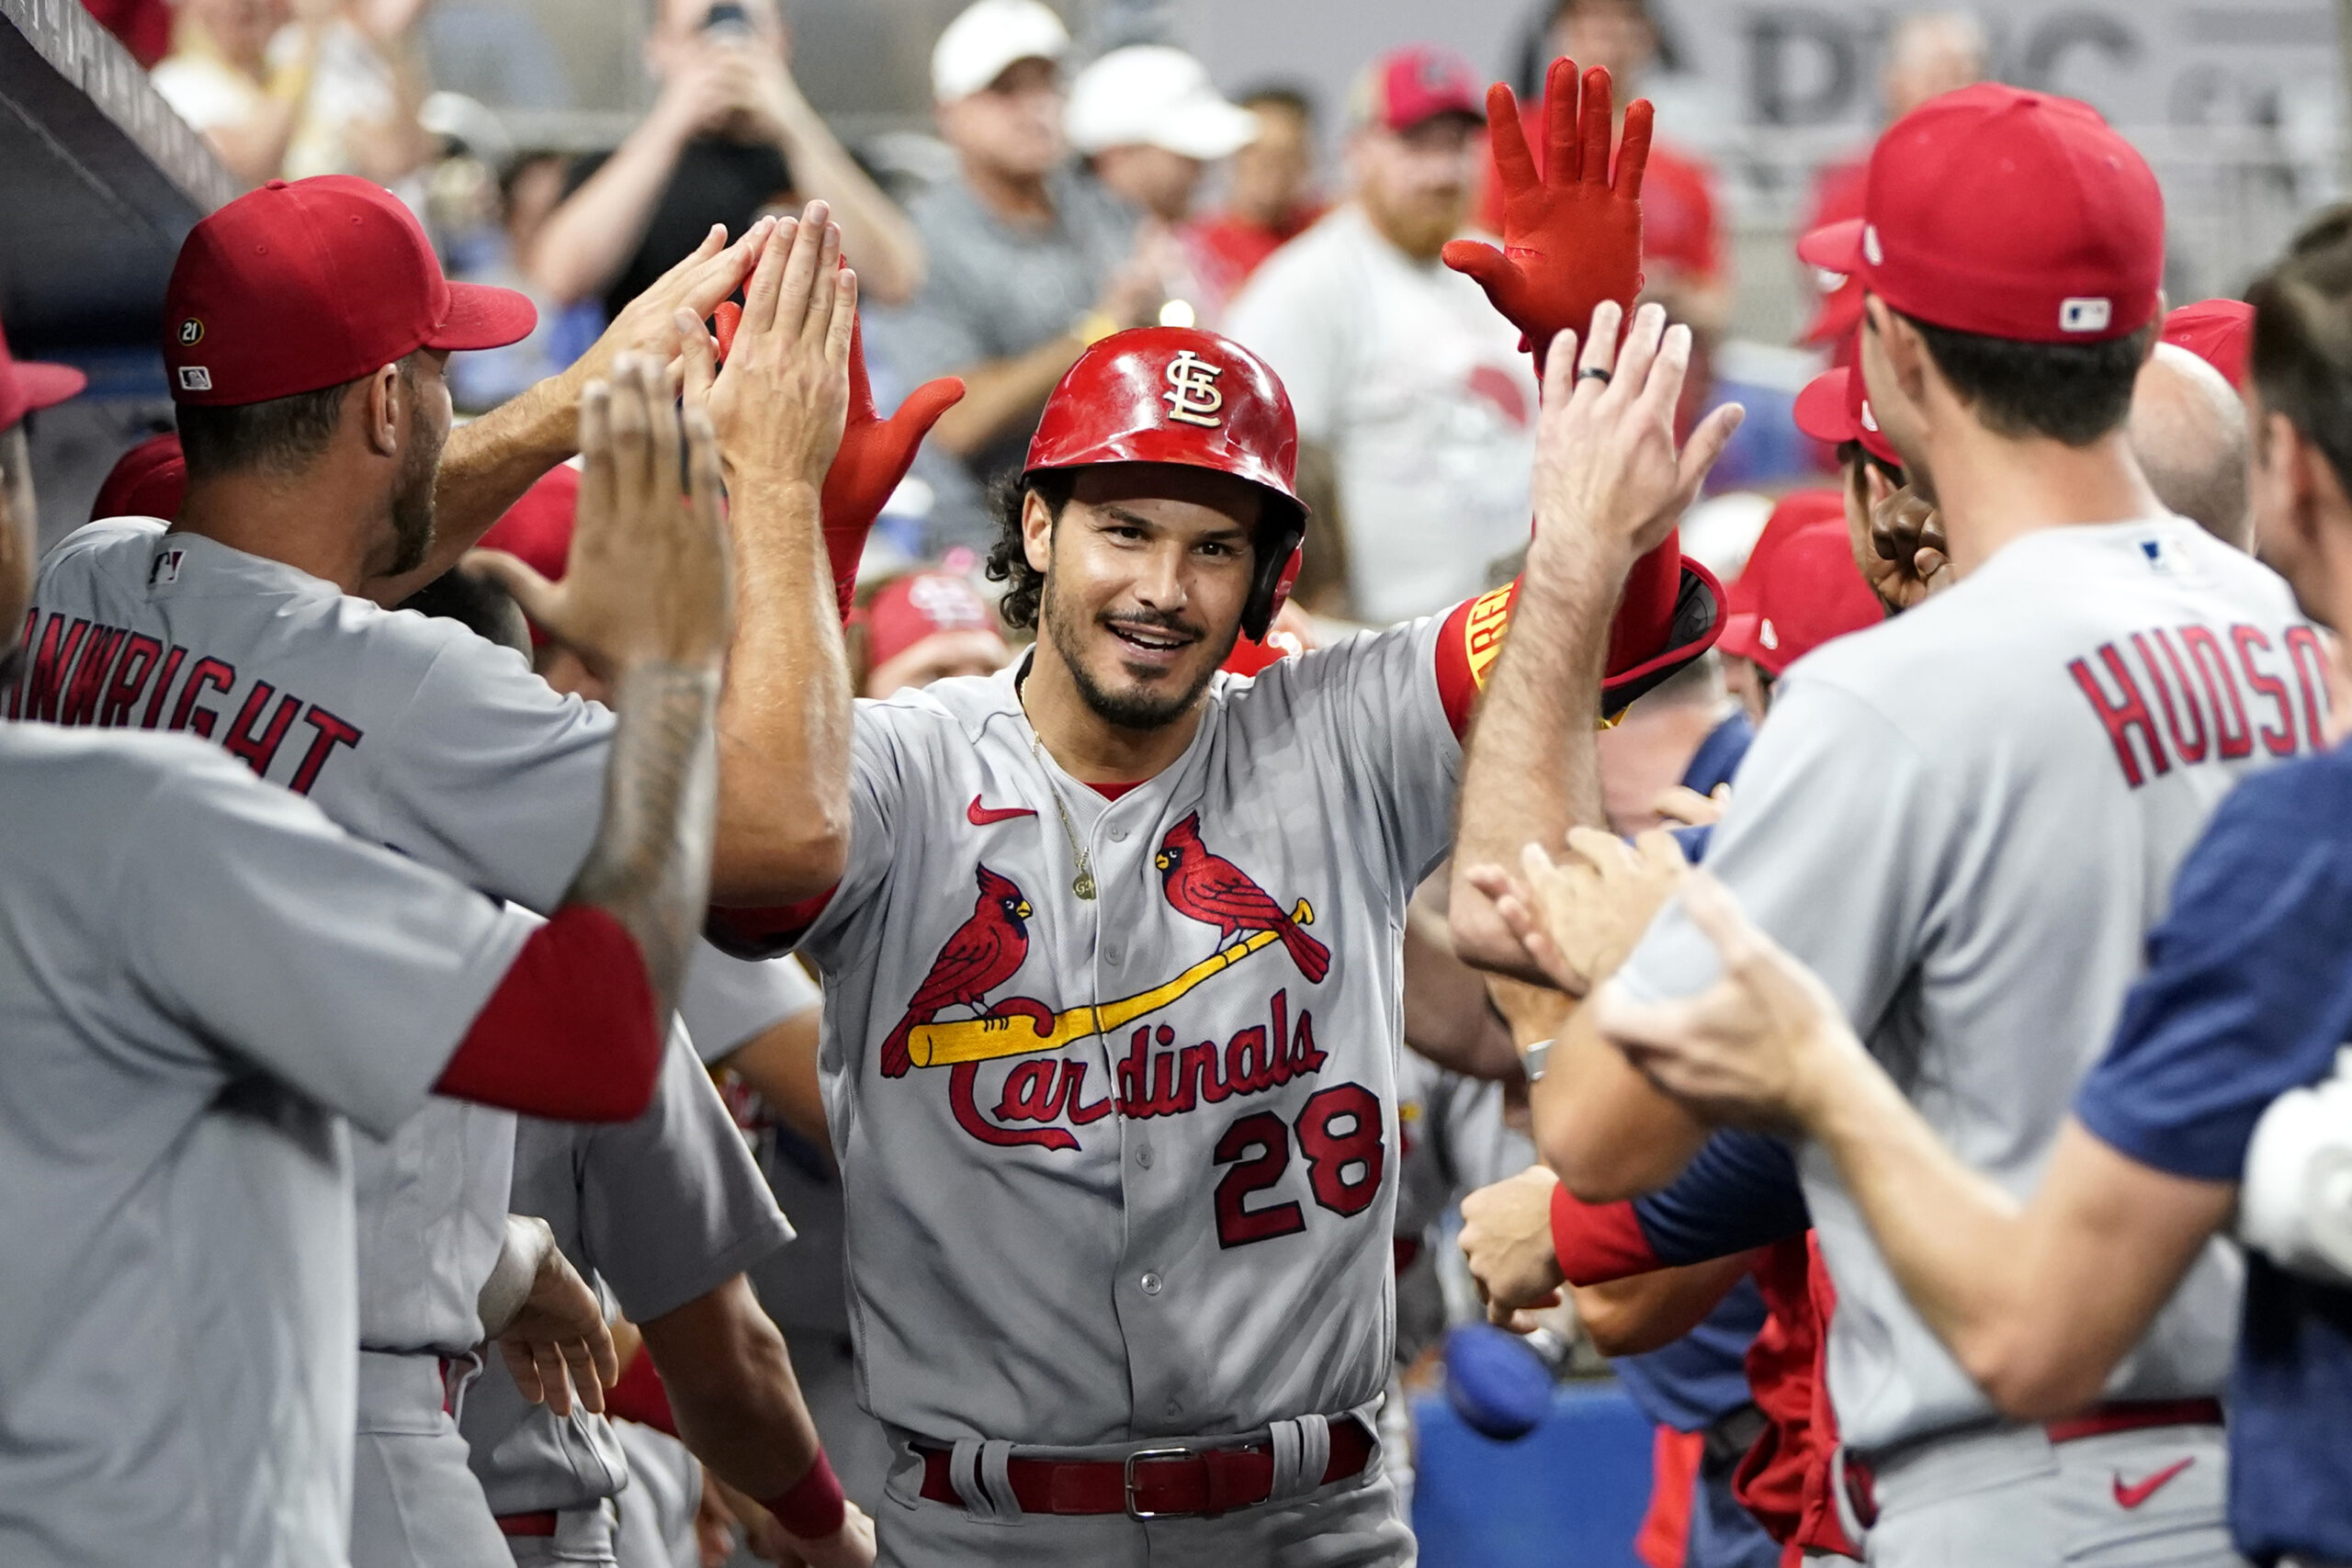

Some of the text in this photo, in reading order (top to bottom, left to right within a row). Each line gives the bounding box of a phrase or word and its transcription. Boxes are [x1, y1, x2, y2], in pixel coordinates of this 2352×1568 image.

[182, 321, 198, 341] 21
[947, 987, 1329, 1153] Cardinals
[1213, 1081, 1385, 1251] 28
